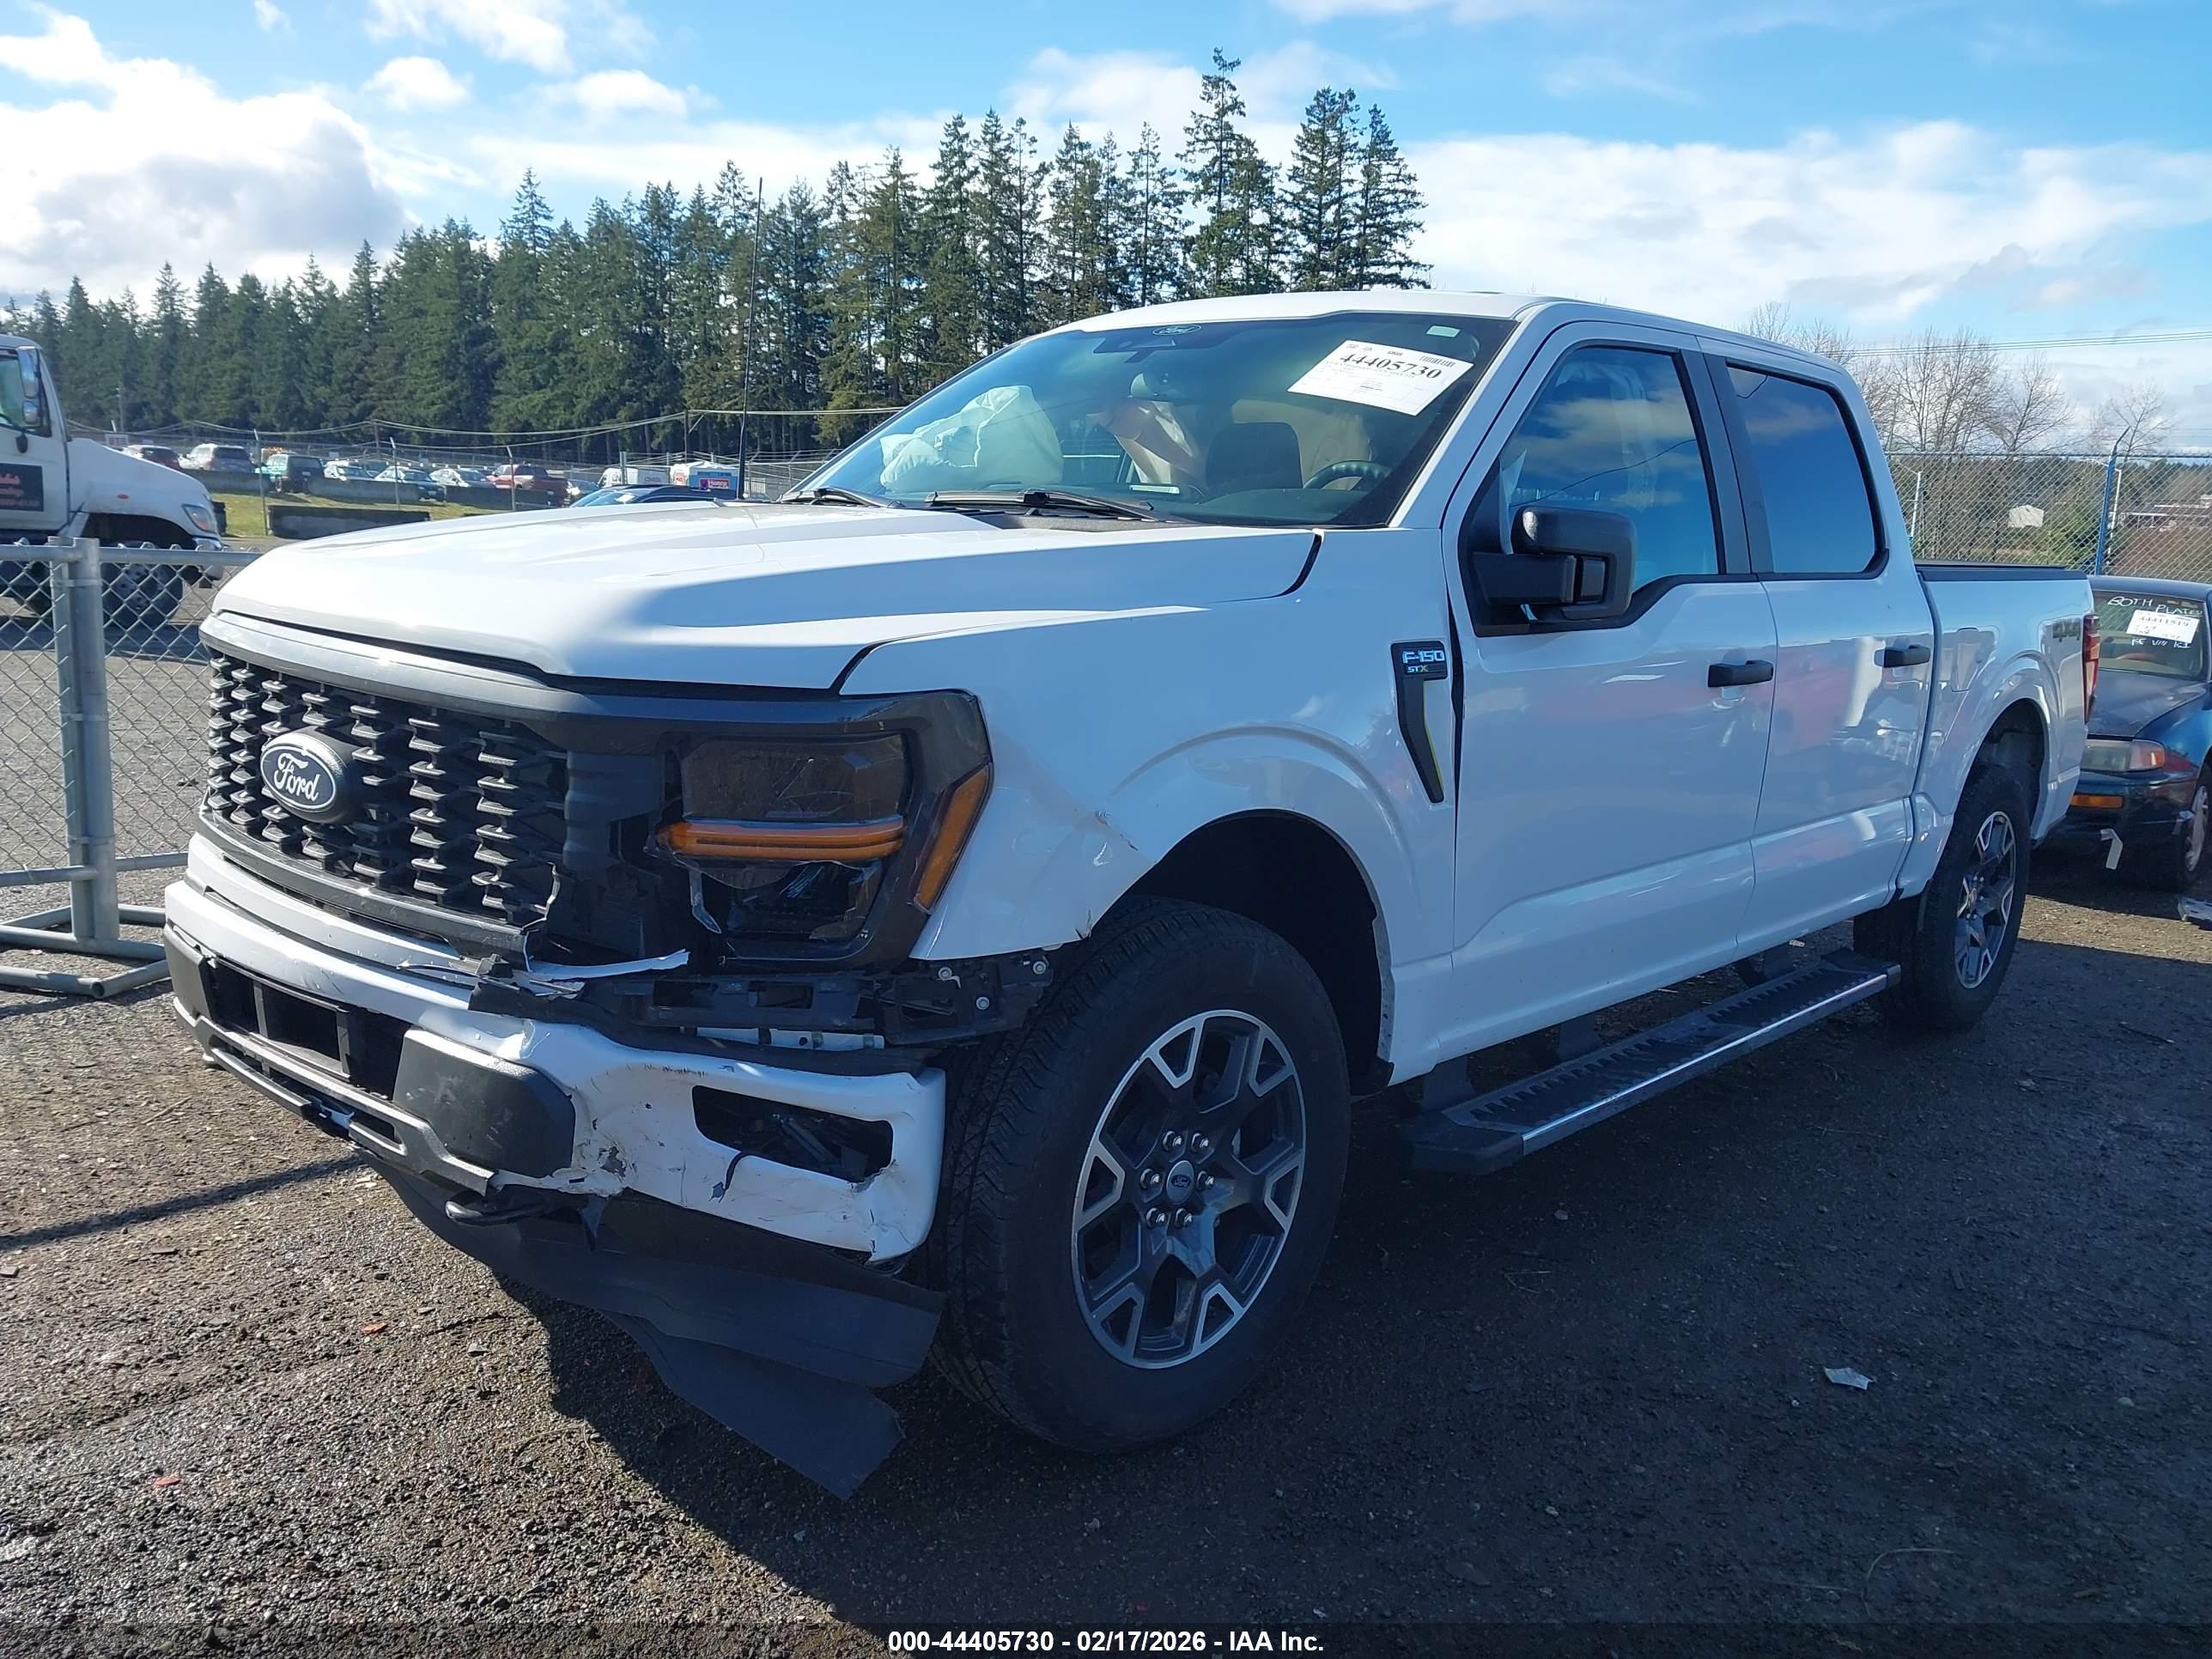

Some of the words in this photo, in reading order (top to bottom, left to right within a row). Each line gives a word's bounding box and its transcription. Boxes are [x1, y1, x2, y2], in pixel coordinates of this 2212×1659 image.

[1340, 353, 1443, 380] 44405730
[2107, 596, 2154, 607] BOTH
[1402, 649, 1445, 664] F-150
[273, 752, 321, 802] Ford
